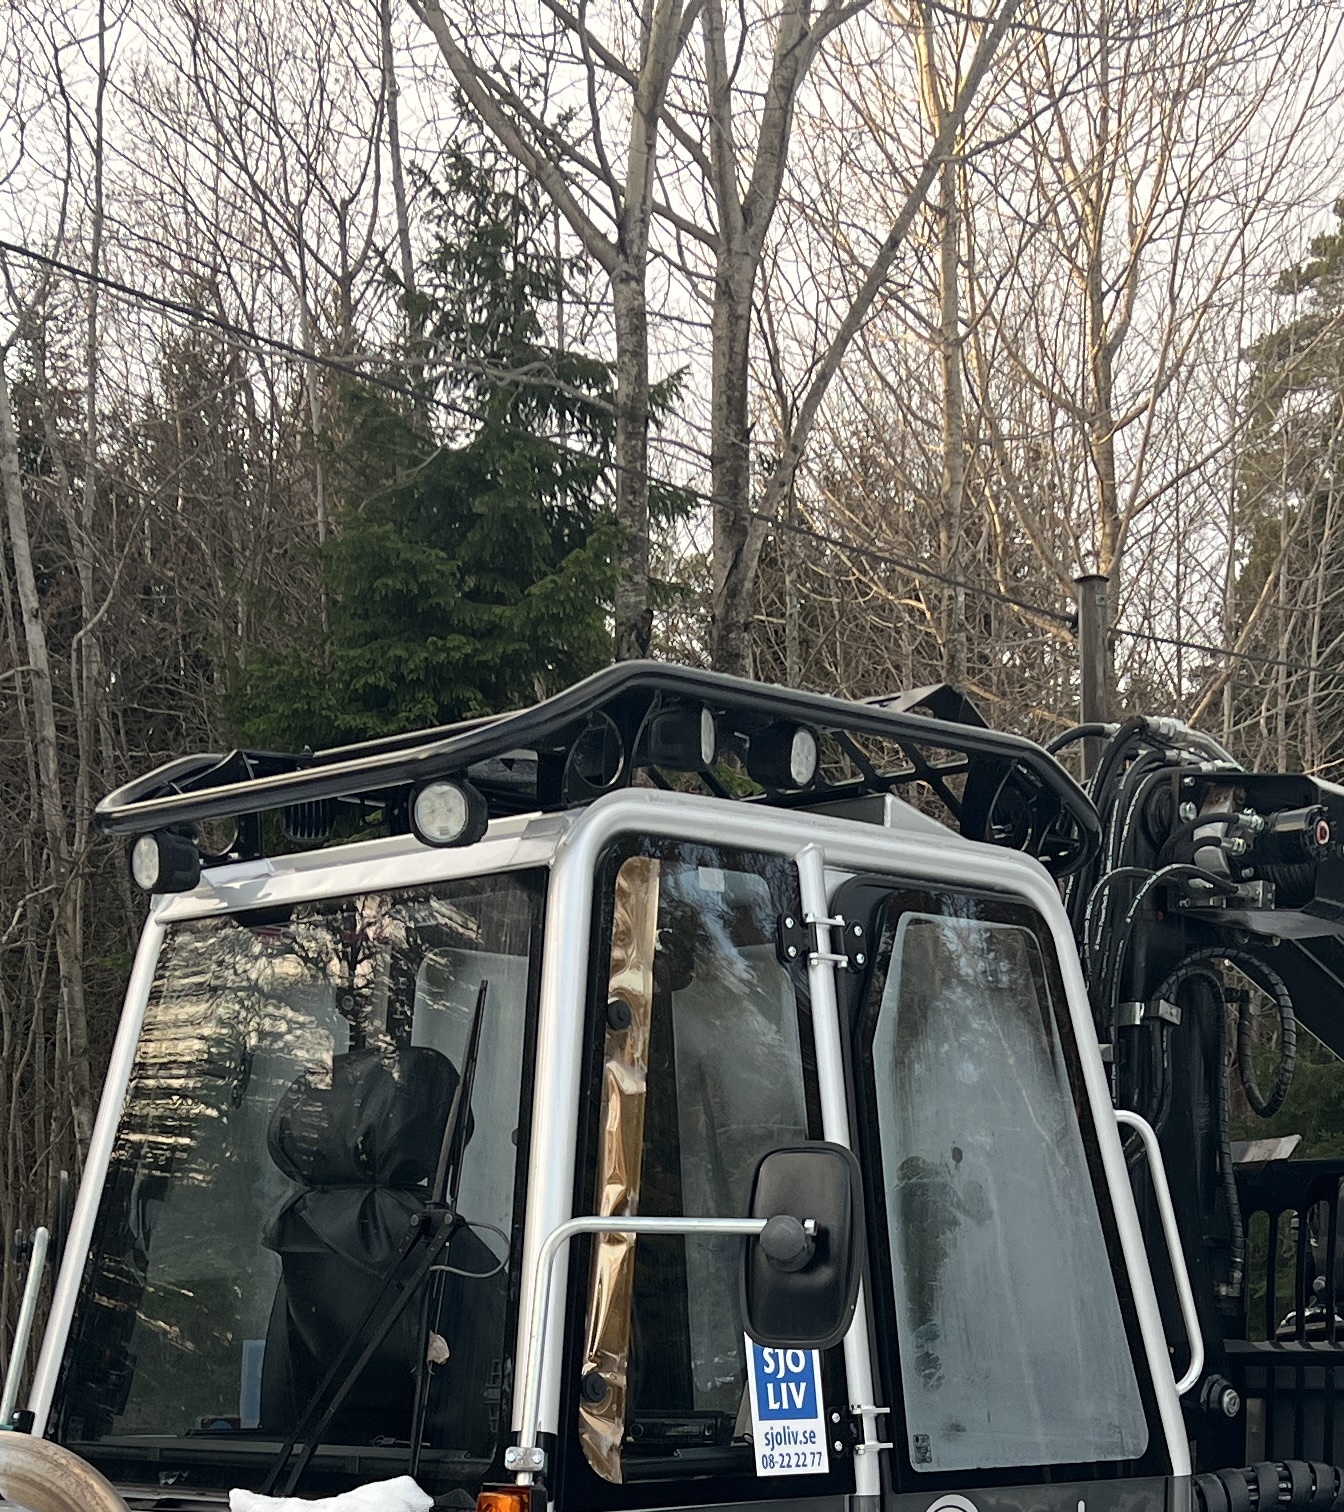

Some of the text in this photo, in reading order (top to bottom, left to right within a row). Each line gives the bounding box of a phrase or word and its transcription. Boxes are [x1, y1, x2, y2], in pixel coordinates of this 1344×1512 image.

[766, 1382, 807, 1410] LIV
[764, 1426, 817, 1451] sjoliv.se
[761, 1451, 823, 1469] 08-22 22 77
